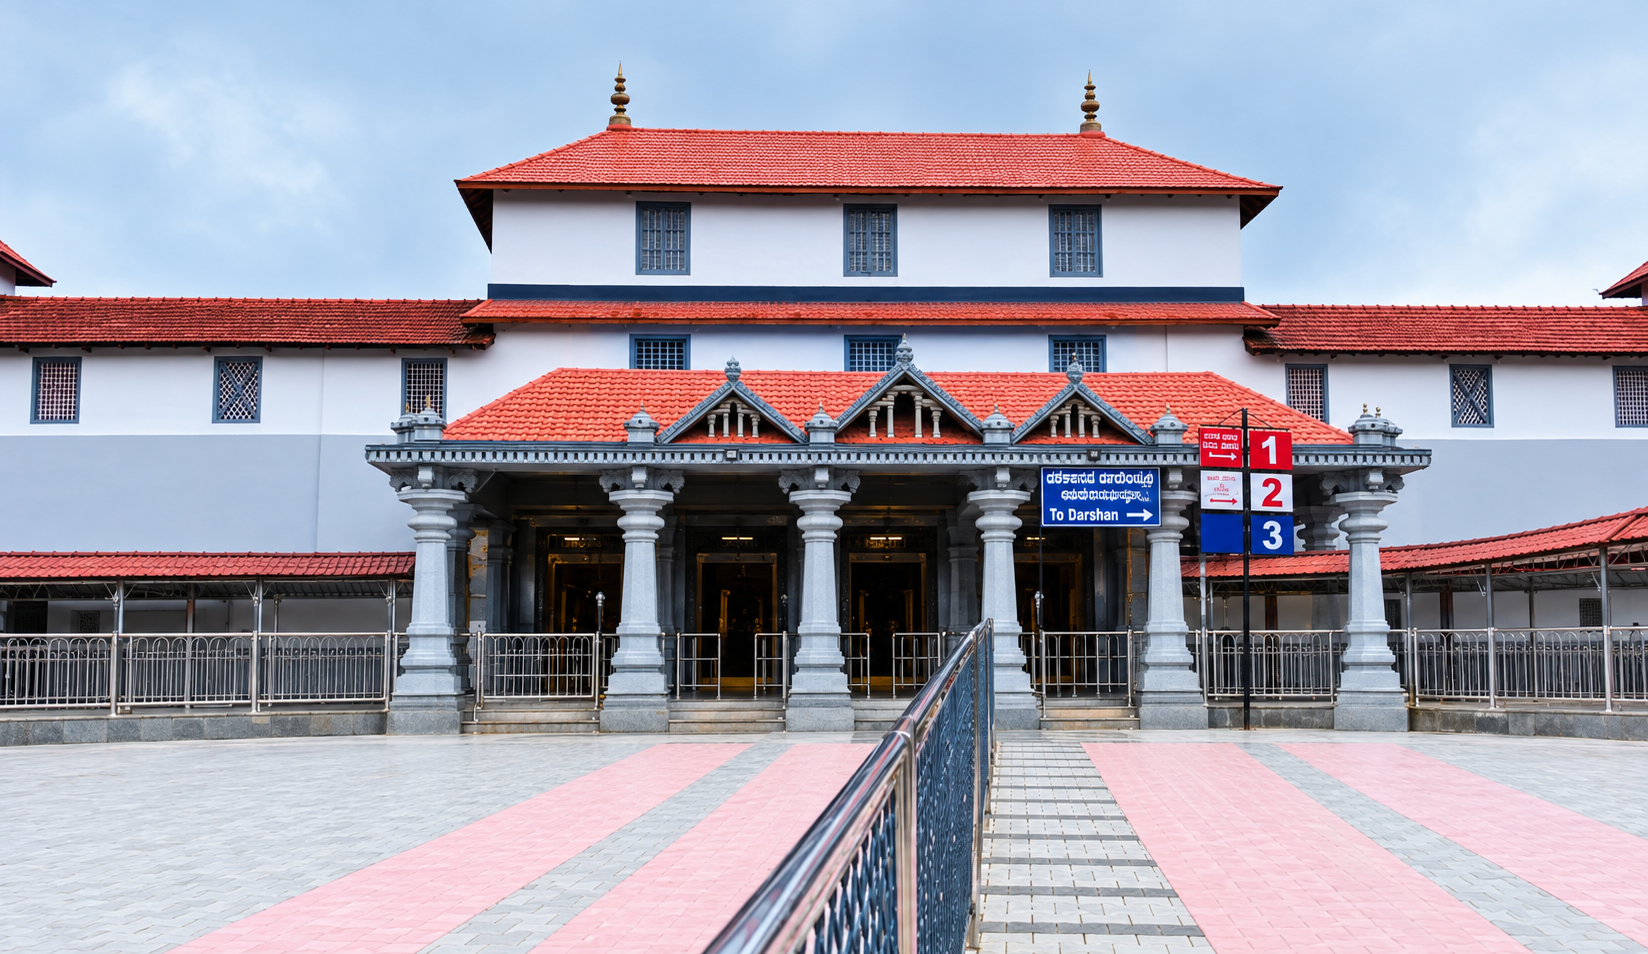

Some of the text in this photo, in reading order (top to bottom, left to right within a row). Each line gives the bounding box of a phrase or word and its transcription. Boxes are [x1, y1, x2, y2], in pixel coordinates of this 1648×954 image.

[1262, 436, 1277, 465] 1
[1262, 478, 1283, 508] 2
[1050, 508, 1119, 521] To Darshan
[1262, 520, 1283, 550] 3
